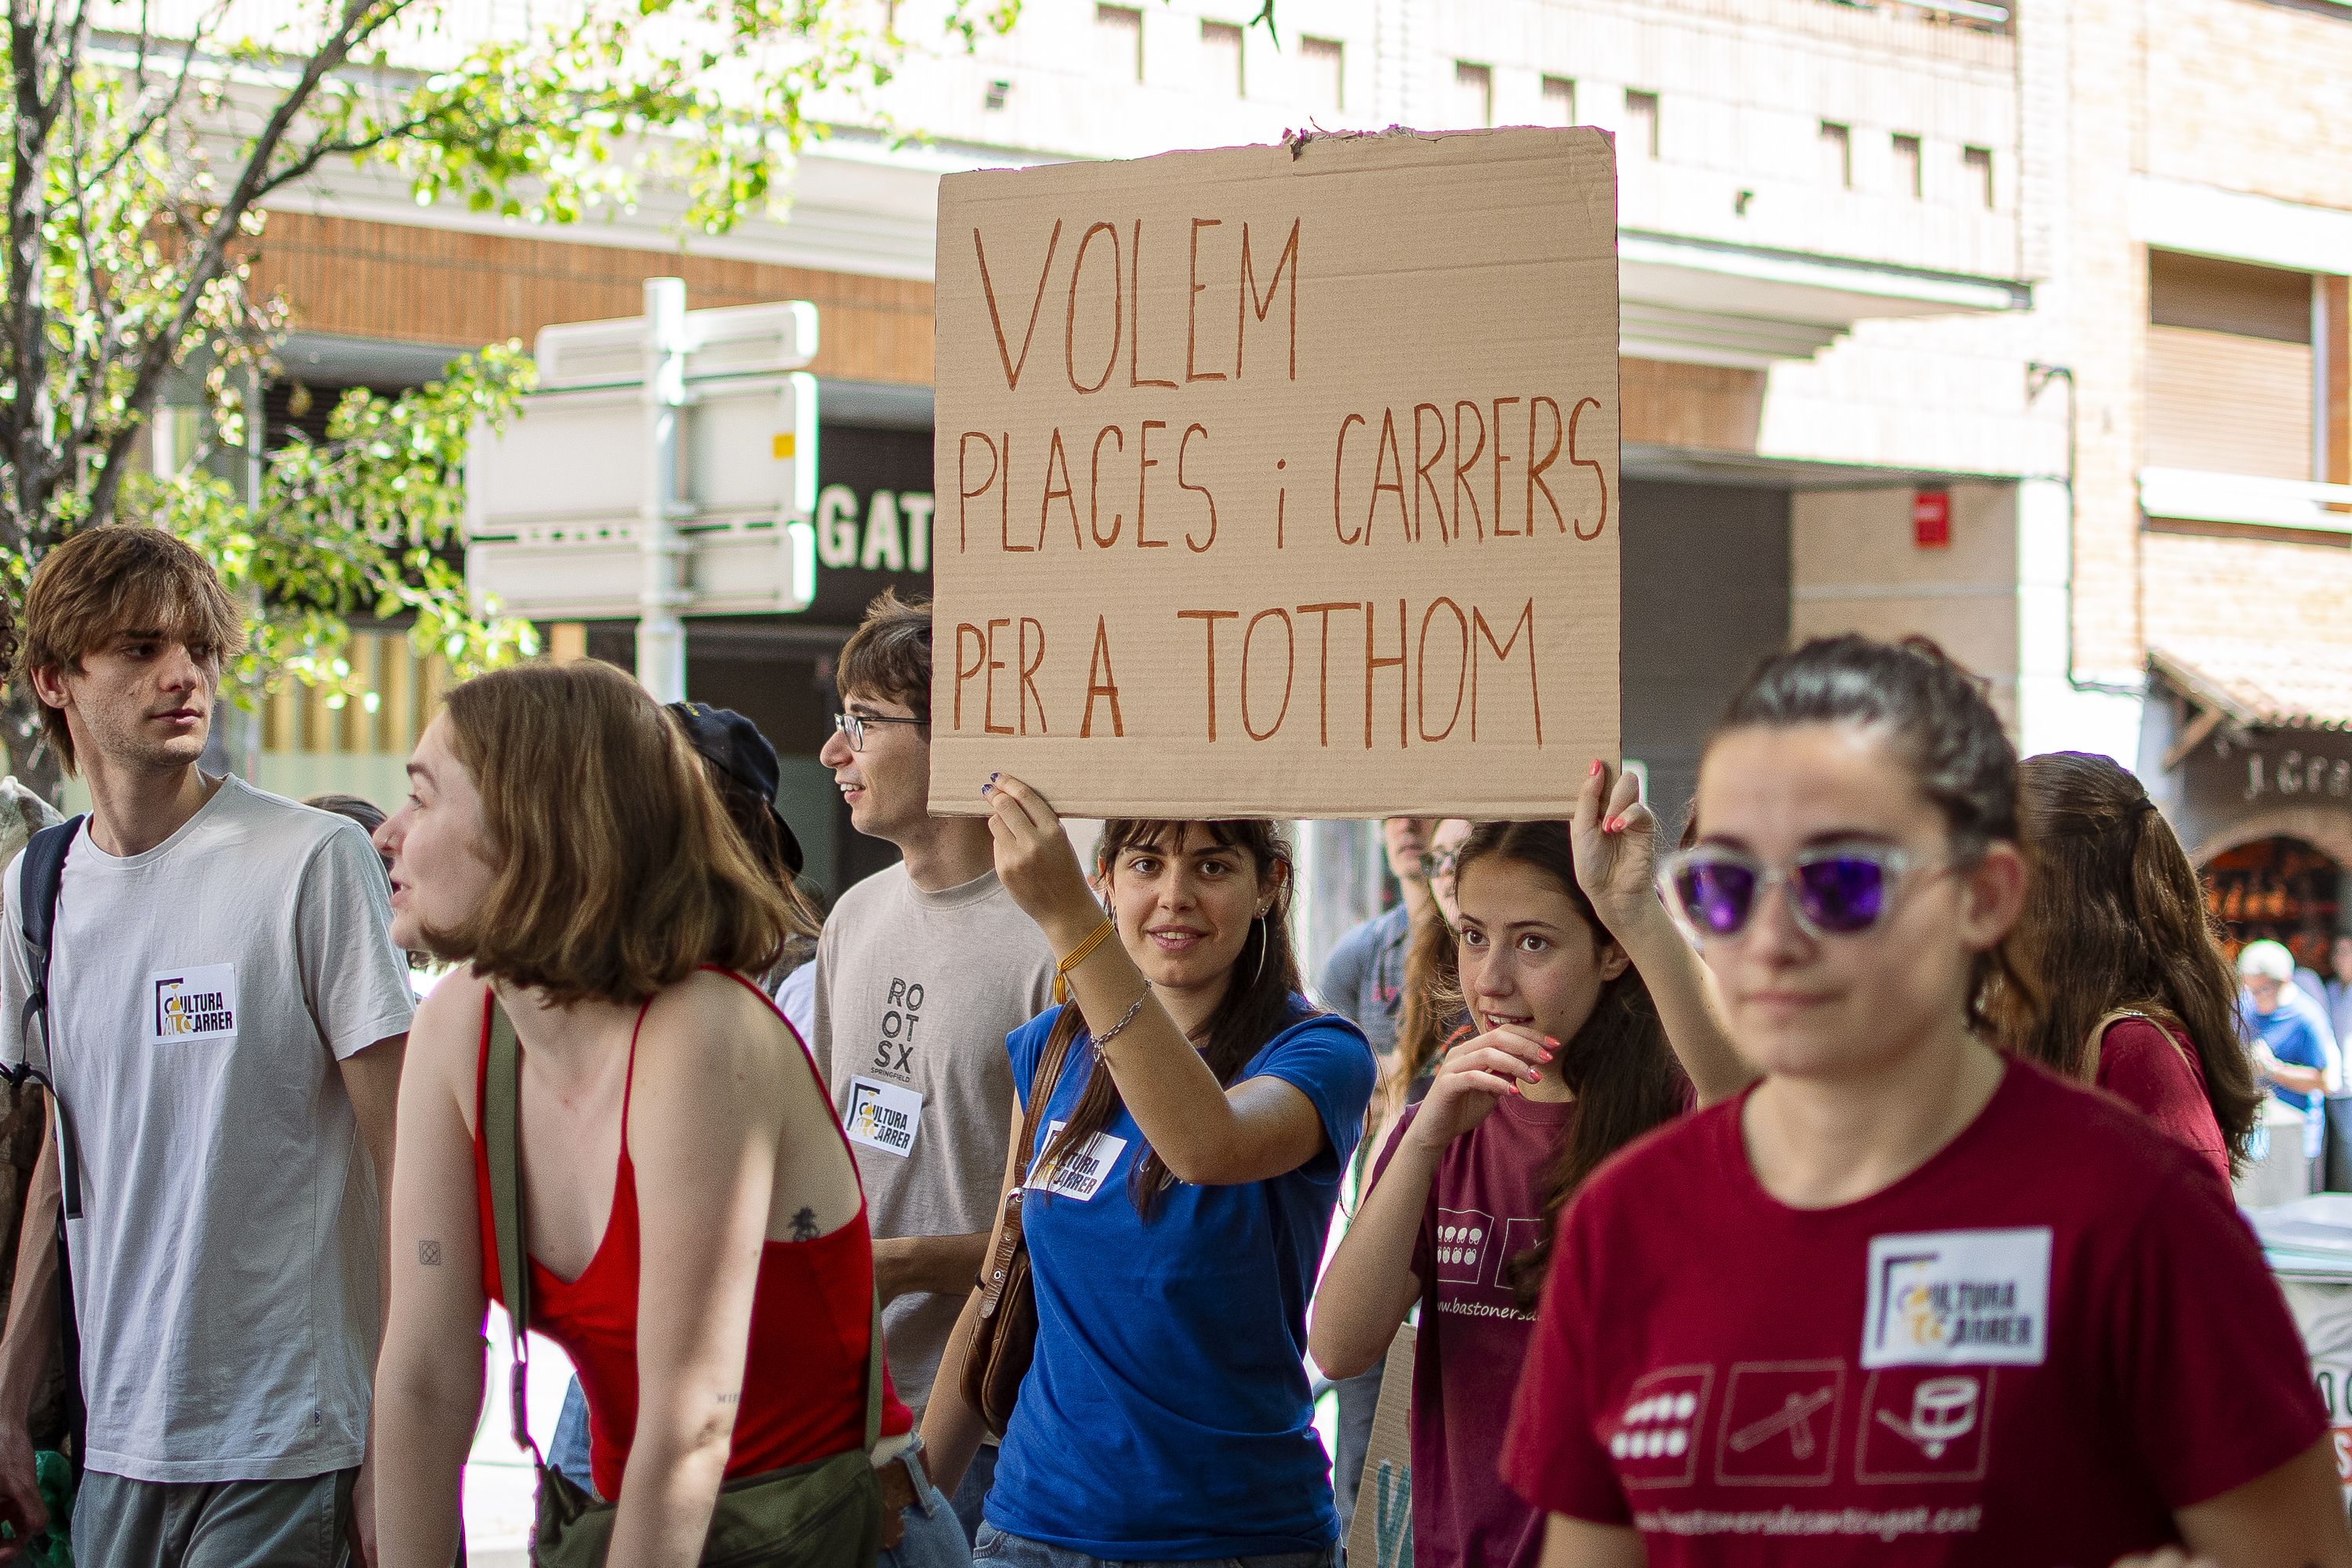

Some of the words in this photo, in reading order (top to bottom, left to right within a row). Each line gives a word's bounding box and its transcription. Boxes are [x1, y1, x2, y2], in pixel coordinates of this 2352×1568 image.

[973, 216, 1301, 395] VOLEM
[959, 420, 1218, 554] PLACES
[1276, 458, 1287, 550] i
[1334, 396, 1608, 547] CARRERS
[953, 616, 1048, 736] PER
[1080, 614, 1124, 739] A
[1177, 596, 1543, 750] TOTHOM
[164, 991, 223, 1014] CULTURA
[858, 1102, 908, 1131] CULTURA
[870, 1067, 910, 1083] SPRINGFIELD
